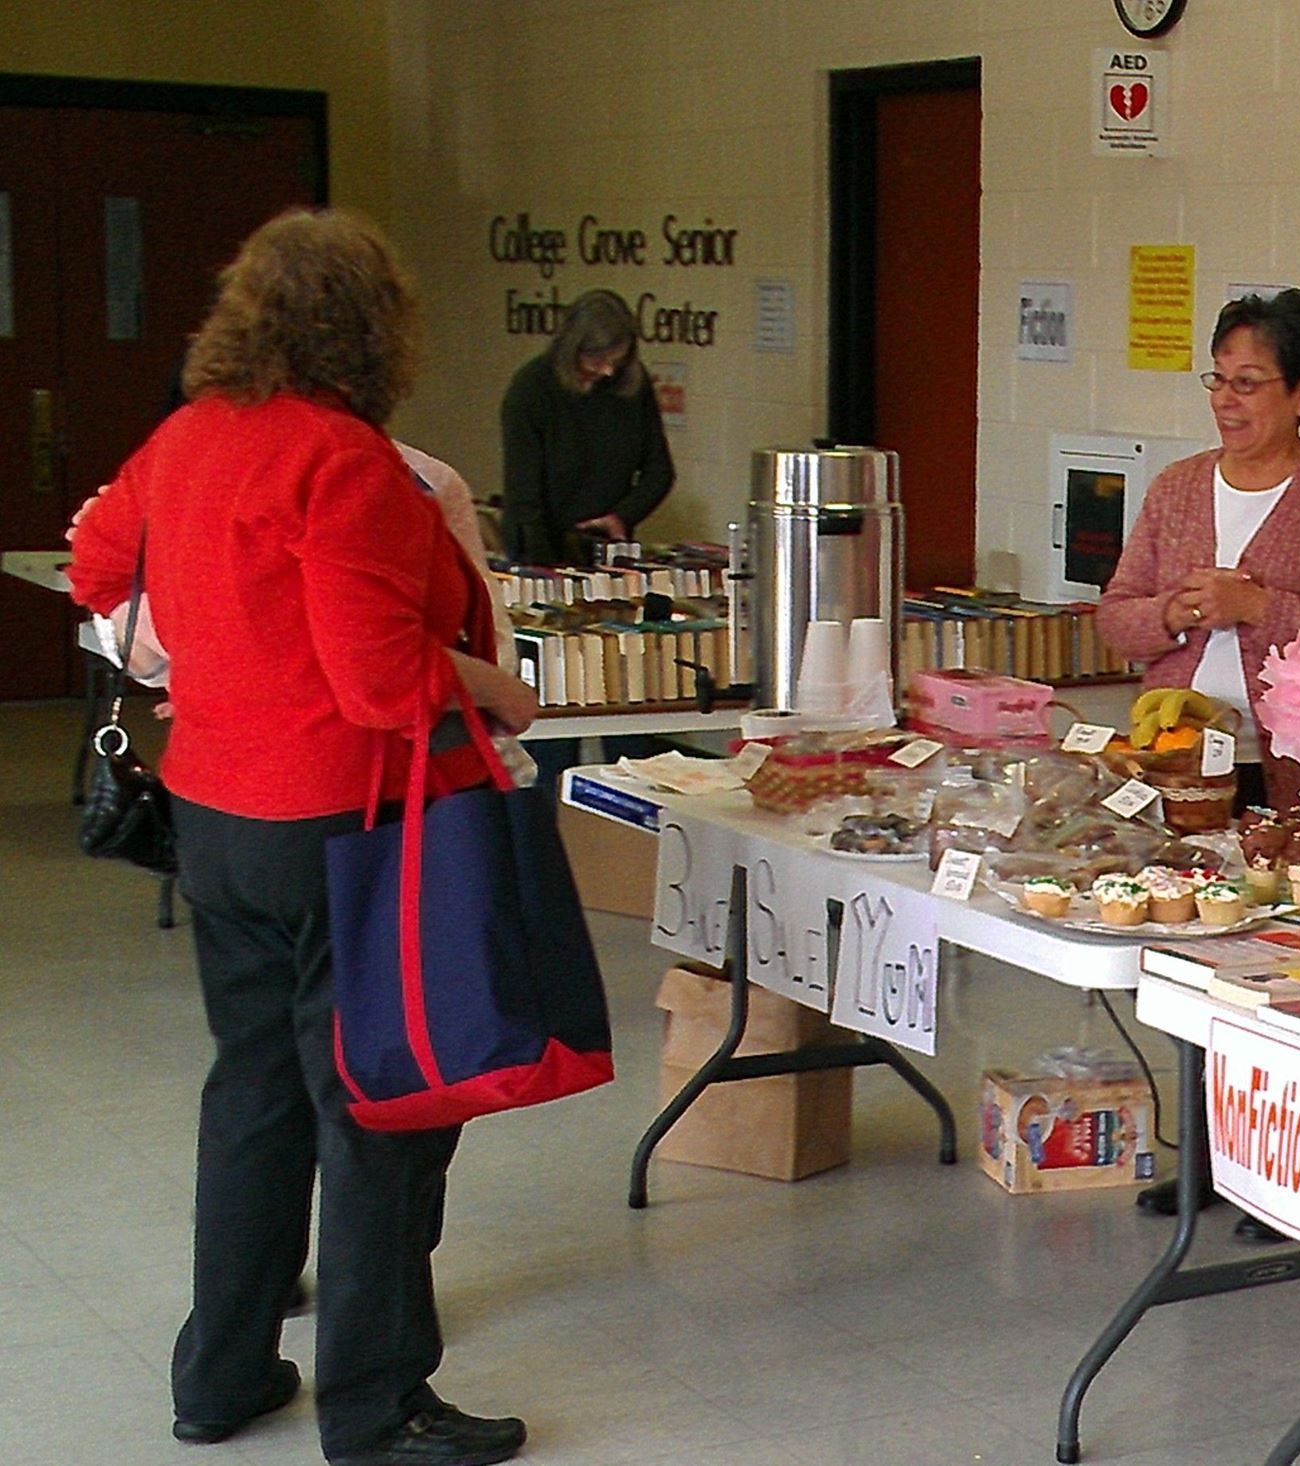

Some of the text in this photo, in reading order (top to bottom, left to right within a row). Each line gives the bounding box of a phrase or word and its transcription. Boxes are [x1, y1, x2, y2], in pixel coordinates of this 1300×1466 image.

[1110, 54, 1148, 71] AED
[489, 213, 737, 279] College Grove Senior
[636, 293, 719, 346] Center
[1019, 297, 1067, 346] Fiction
